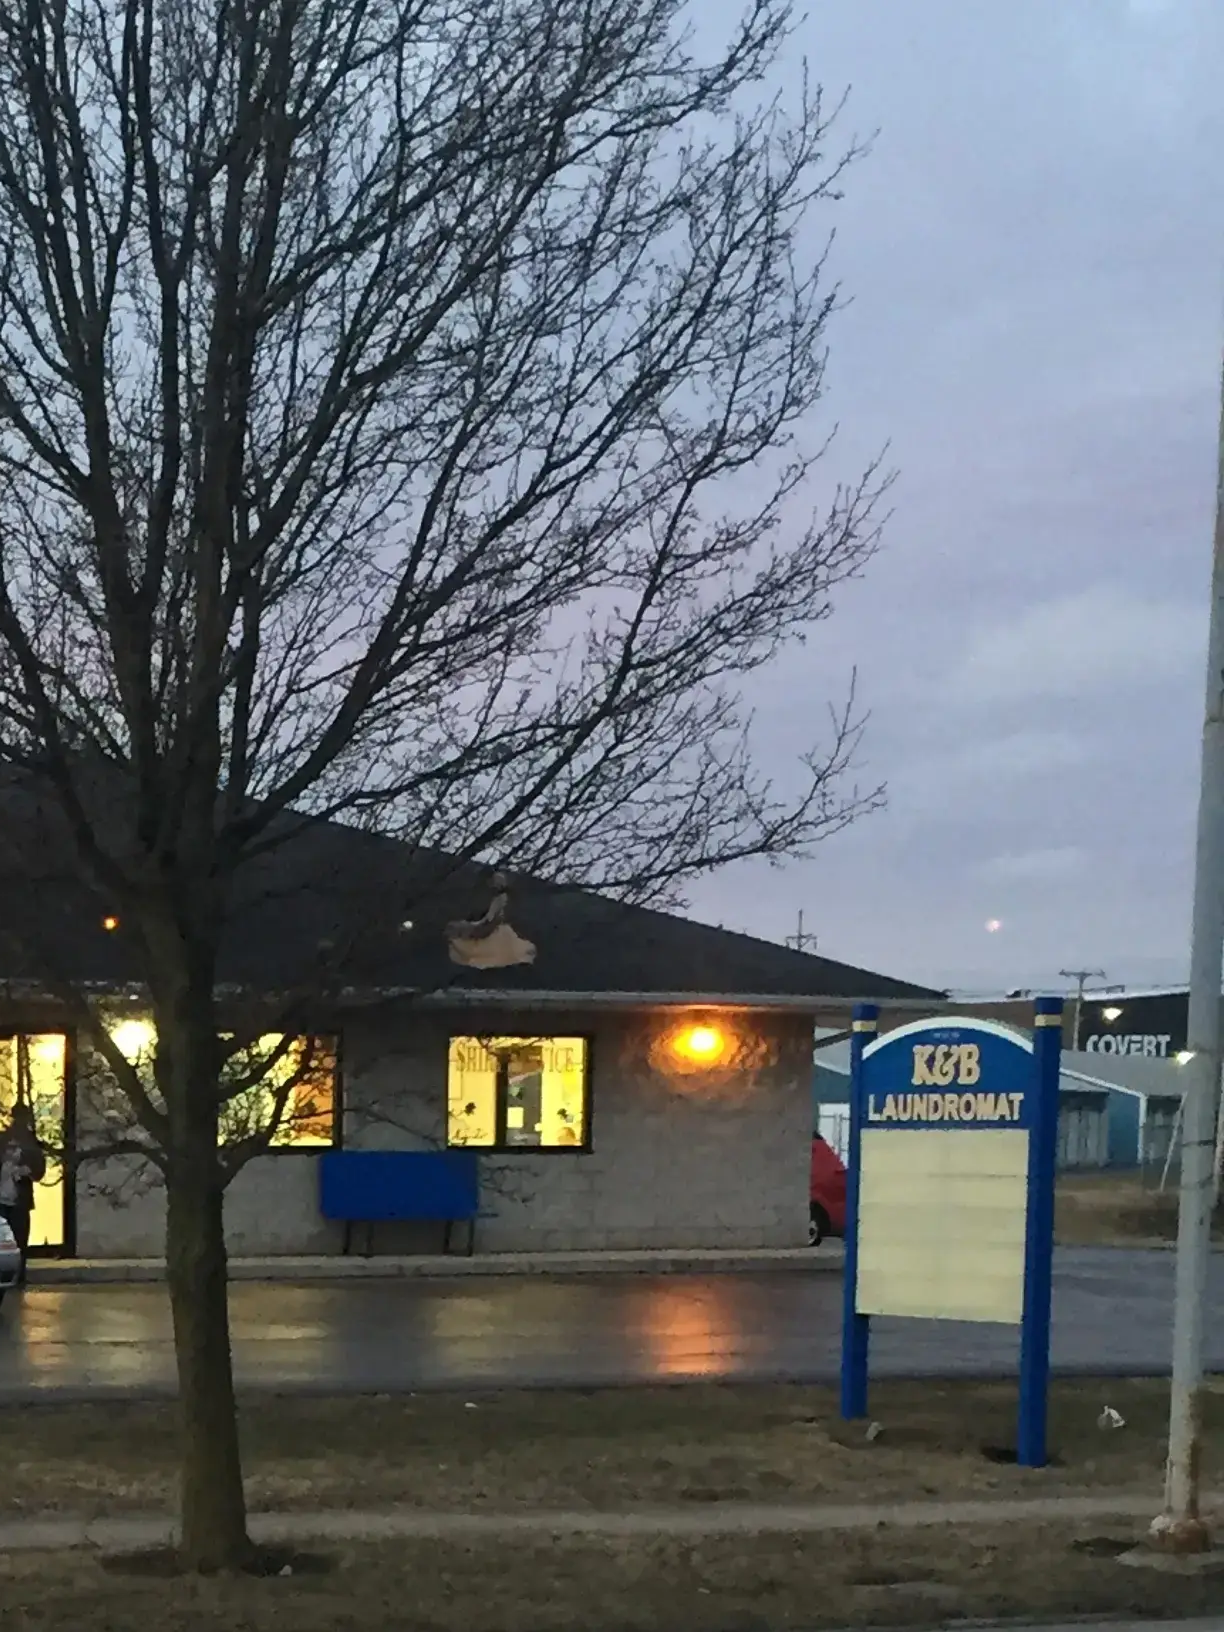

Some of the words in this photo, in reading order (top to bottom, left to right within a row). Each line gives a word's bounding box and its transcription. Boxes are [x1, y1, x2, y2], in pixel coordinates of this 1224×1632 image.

[1086, 1034, 1171, 1057] COVERT
[911, 1043, 980, 1085] K&B
[868, 1092, 1024, 1121] LAUNDROMAT
